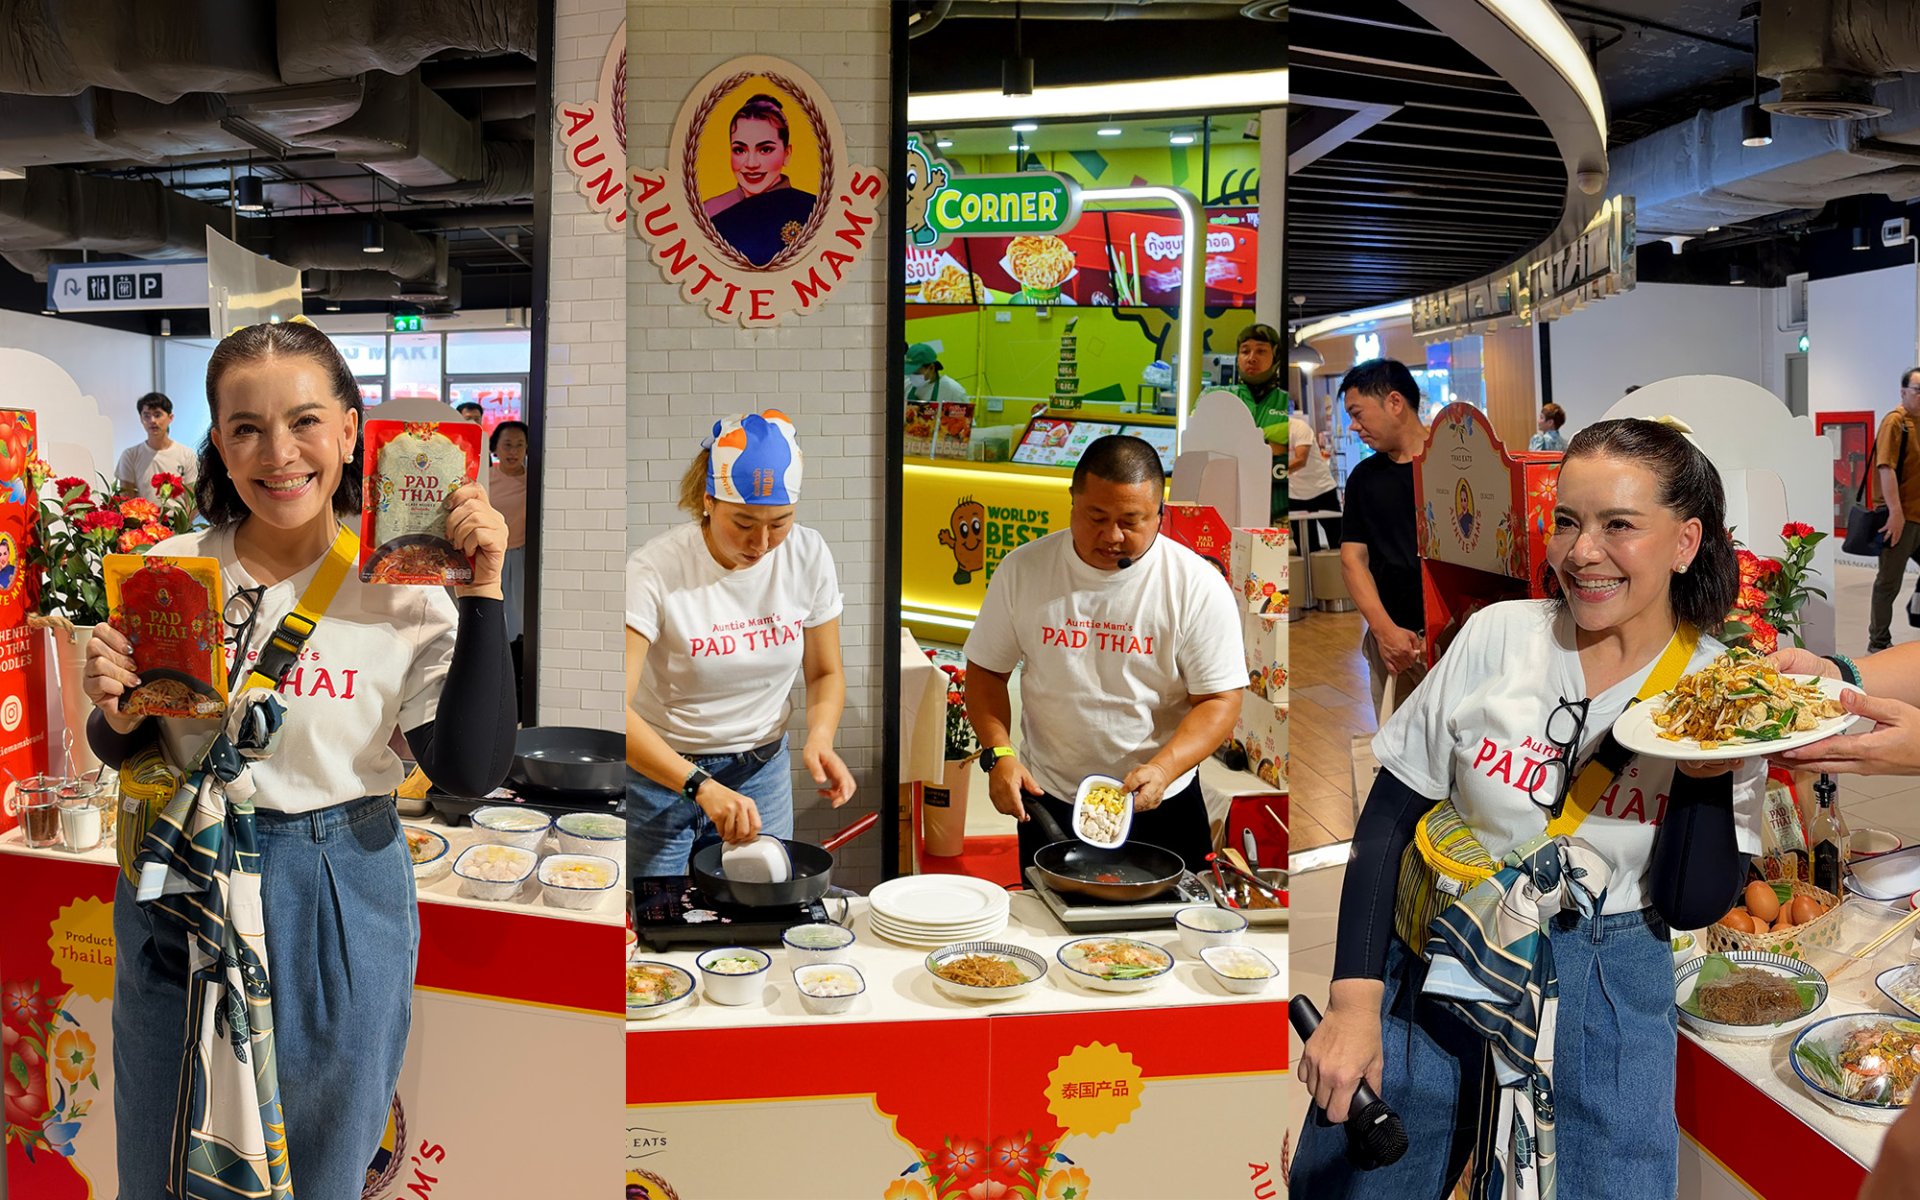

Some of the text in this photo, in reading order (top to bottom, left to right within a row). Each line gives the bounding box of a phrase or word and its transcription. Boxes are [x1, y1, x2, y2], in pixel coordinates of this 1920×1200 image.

[564, 107, 627, 224] AUN
[633, 171, 882, 321] AUNTIE MAM'S
[404, 475, 439, 489] PAD
[398, 488, 444, 503] THAI
[987, 506, 1049, 525] WORLD'S
[986, 521, 1049, 547] BEST
[986, 547, 1010, 560] FLA
[149, 609, 182, 625] PAD
[712, 613, 781, 633] Auntie Mam's
[1065, 618, 1133, 632] Auntie Mam's
[146, 622, 188, 639] THAI
[5, 639, 30, 656] THAI
[689, 635, 737, 657] PAD
[1042, 626, 1154, 655] PAD THAI
[0, 654, 32, 673] ODLES
[278, 666, 359, 700] HAI
[1520, 735, 1565, 759] Aunt
[1473, 737, 1548, 793] PAD
[1590, 783, 1670, 827] HAI
[1768, 806, 1787, 819] PAD
[1769, 815, 1792, 830] THAI
[65, 930, 115, 948] Product
[59, 944, 117, 967] Thaila
[1061, 1080, 1129, 1100] 泰国产品
[633, 1137, 668, 1148] EATS
[396, 1139, 446, 1200] M'S
